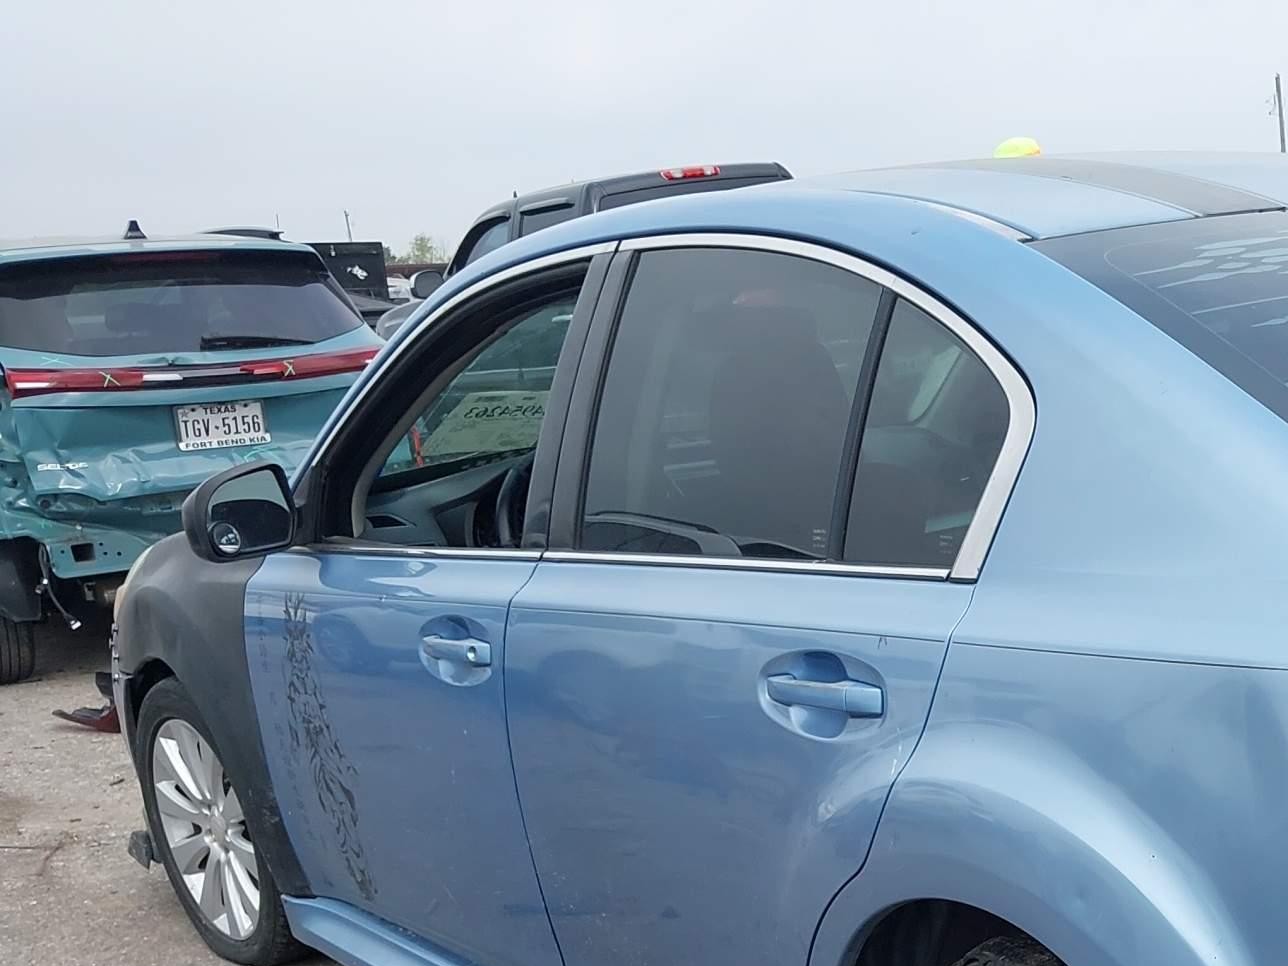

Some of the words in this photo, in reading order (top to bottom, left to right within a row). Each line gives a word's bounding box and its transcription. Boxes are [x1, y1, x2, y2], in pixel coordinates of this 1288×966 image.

[202, 405, 237, 415] TEXAS
[181, 417, 211, 439] TGV
[222, 414, 261, 436] 5156
[216, 438, 247, 447] BEND
[248, 435, 268, 443] KIA
